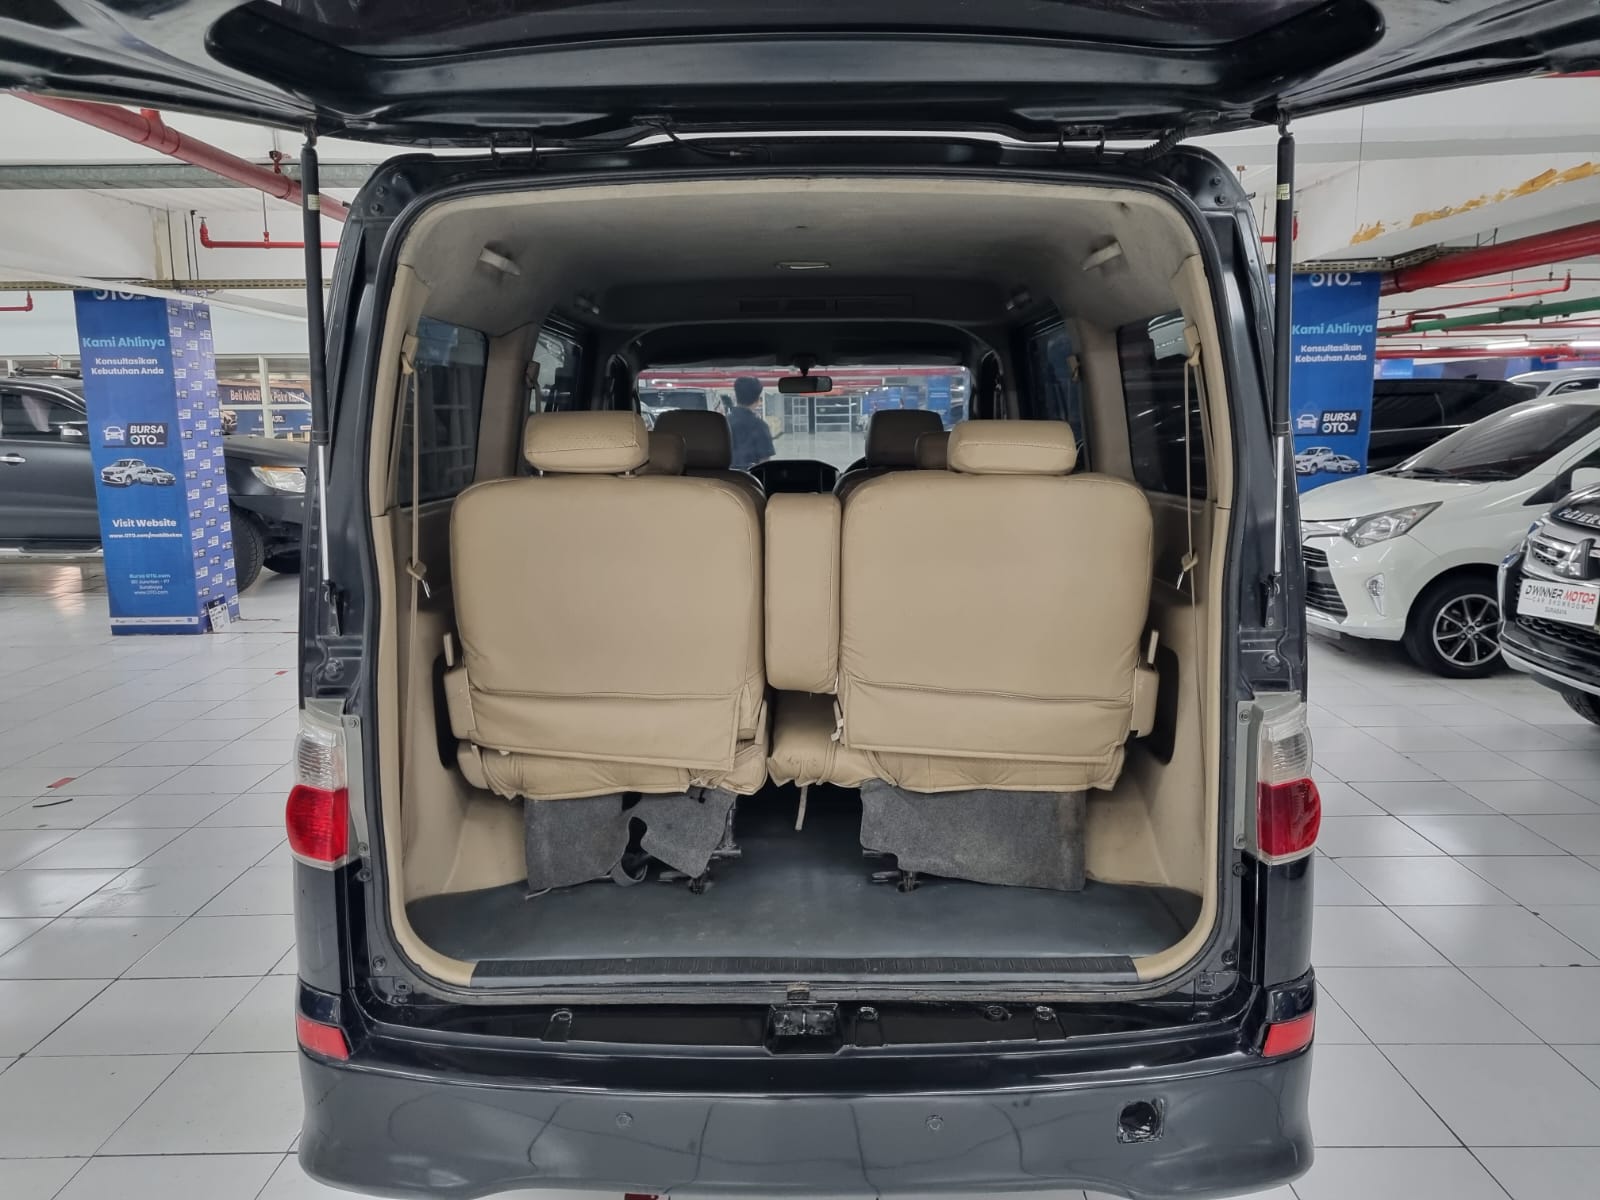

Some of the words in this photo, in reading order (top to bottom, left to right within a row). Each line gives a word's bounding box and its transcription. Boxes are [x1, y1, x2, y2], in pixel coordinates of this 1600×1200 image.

[1292, 323, 1324, 335] Kami
[1326, 322, 1373, 336] Ahlinya
[83, 336, 116, 348] Kami
[118, 336, 165, 350] Ahlinya
[1301, 344, 1362, 352] Konsultasikan
[95, 357, 158, 365] Konsultasikan
[1295, 354, 1343, 363] Kebutuhan
[1344, 353, 1367, 361] Anda
[91, 367, 140, 375] Kebutuhan
[141, 367, 165, 375] Anda
[230, 389, 243, 401] Beli
[243, 389, 261, 401] Mobil
[1323, 412, 1357, 422] BURSA
[129, 425, 165, 434] BURSA
[1558, 508, 1600, 525] PAJER
[112, 518, 135, 527] Visit
[137, 518, 177, 527] Website
[1564, 590, 1596, 604] MOTOR
